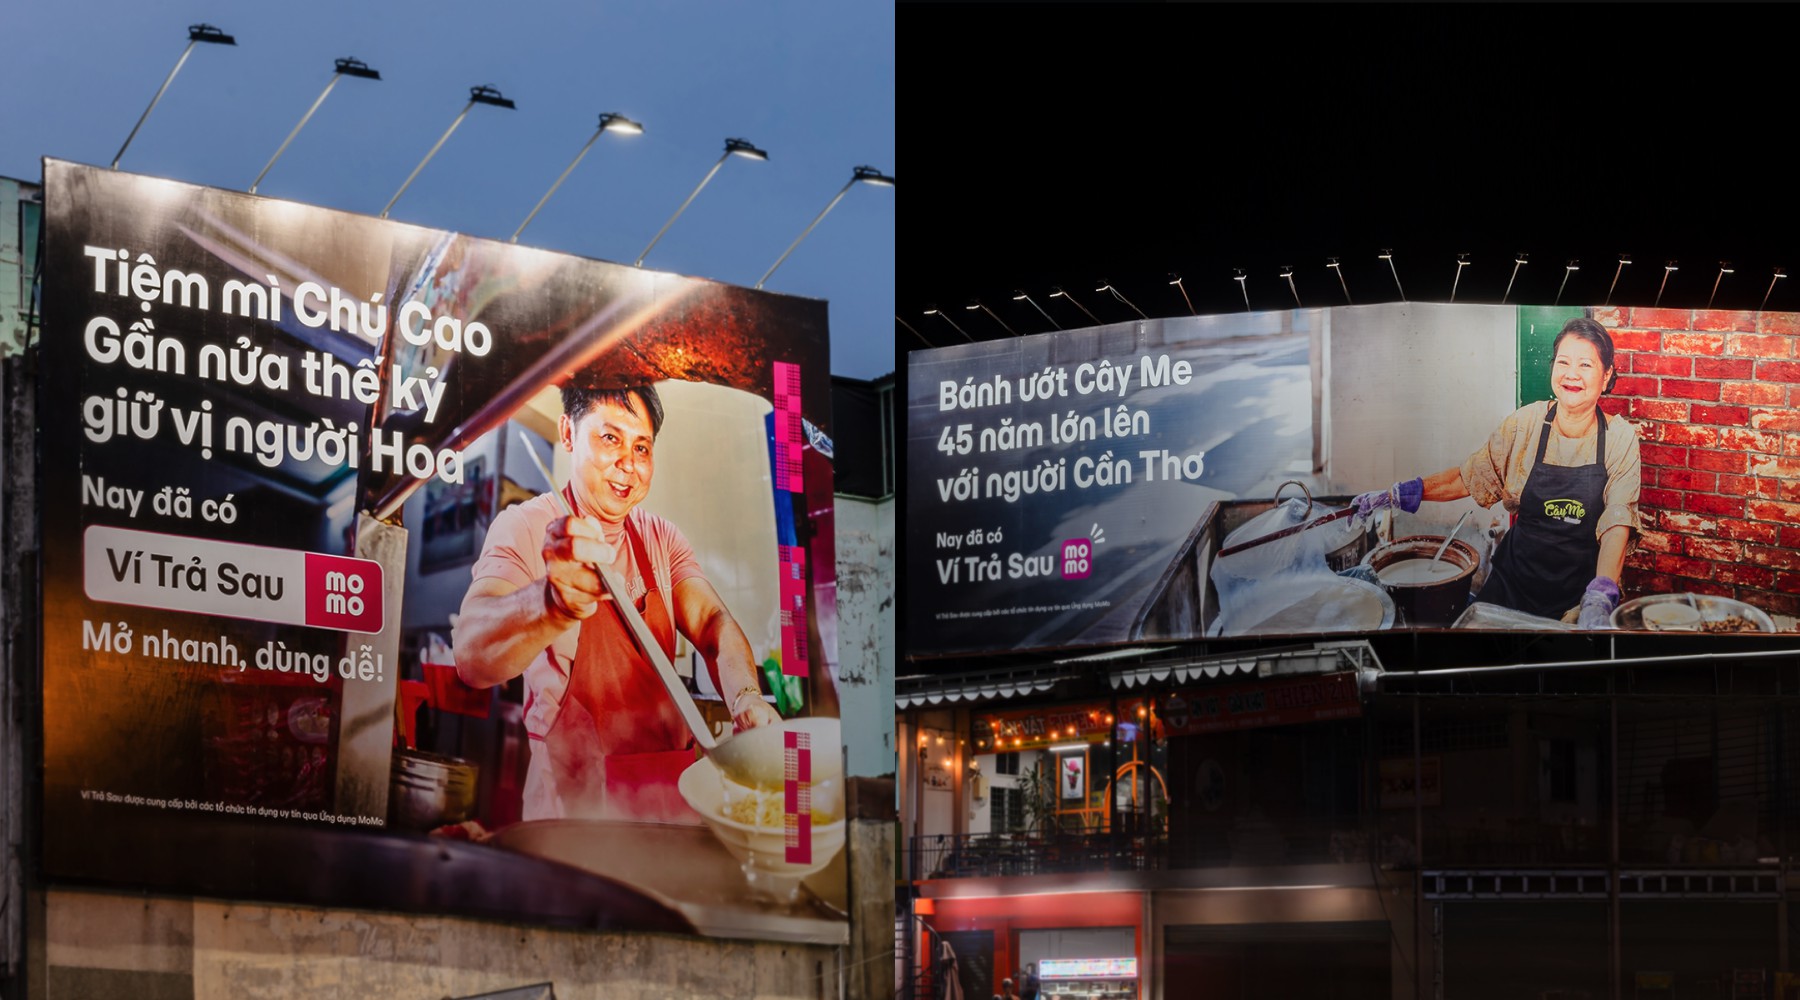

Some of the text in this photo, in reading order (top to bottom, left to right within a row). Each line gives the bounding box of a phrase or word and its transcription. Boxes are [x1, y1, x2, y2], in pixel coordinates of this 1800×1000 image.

[84, 245, 492, 357] Tiệm mì Chú Cao
[84, 316, 447, 424] Gần nửa thế kỷ
[939, 354, 1193, 412] Bánh ướt Cây Me
[83, 387, 465, 485] giữ vị người Hoa
[937, 404, 1150, 456] 45 năm lớn lên
[82, 474, 237, 525] Nay đã có
[937, 450, 1204, 503] với người Cần Thơ
[936, 527, 1002, 550] Nay đã có
[106, 548, 284, 601] Ví Trả Sau
[325, 571, 364, 594] mo
[936, 552, 1054, 584] Ví Trả Sau
[325, 593, 364, 616] mo
[82, 620, 384, 683] Mở nhanh, dùng dễ!
[106, 792, 122, 802] Sau
[146, 798, 166, 809] cung
[279, 809, 289, 819] uy
[303, 811, 318, 821] qua
[358, 815, 384, 826] MoMo
